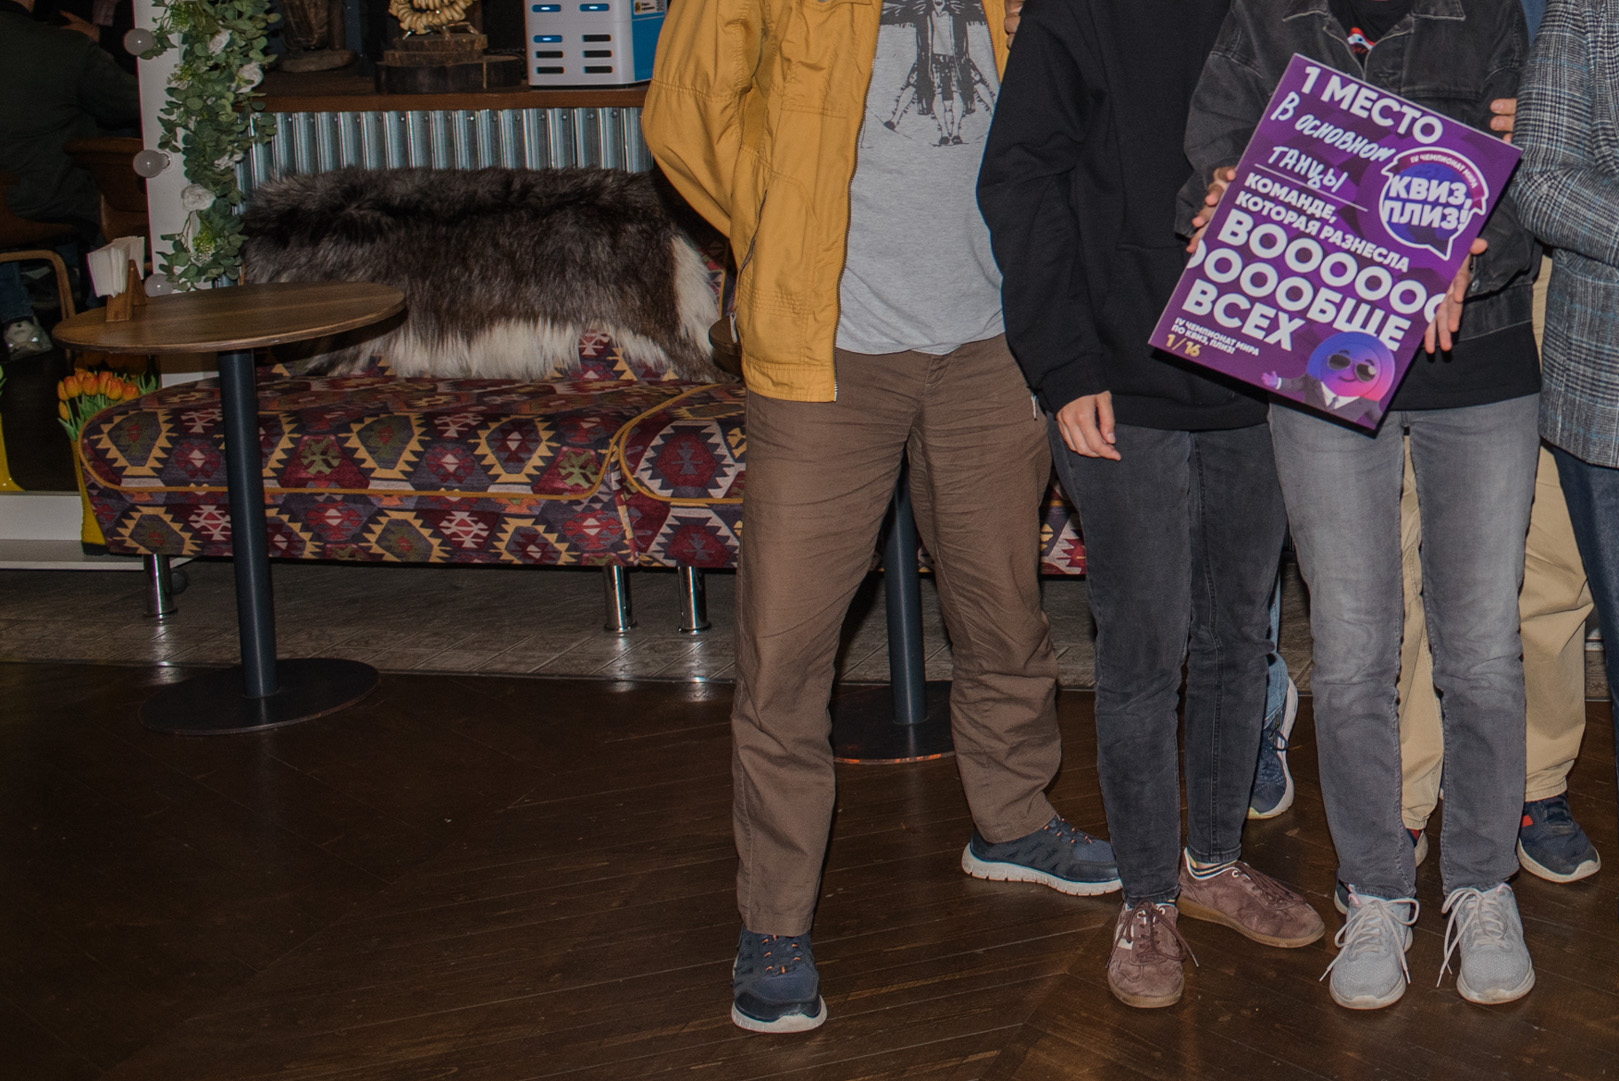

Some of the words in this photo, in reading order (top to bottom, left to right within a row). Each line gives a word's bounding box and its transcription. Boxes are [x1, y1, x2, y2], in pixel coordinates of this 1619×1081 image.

[1270, 91, 1300, 121] В
[1301, 66, 1321, 94] 1
[1320, 74, 1443, 144] МЕСТО
[1420, 154, 1466, 172] ЧЕМПИОНАТ
[1462, 169, 1478, 188] МИРА
[1244, 171, 1337, 225] КОМАНДЕ,
[1389, 175, 1472, 210] КВИЗ,
[1234, 191, 1323, 234] КОТОРАЯ
[1319, 225, 1410, 272] РАЗНЕСЛА
[1383, 200, 1469, 230] ПЛИЗ!
[1182, 278, 1305, 351] ВСЕХ
[1171, 325, 1186, 334] ПО
[1185, 329, 1209, 345] КВИЗ,
[1209, 339, 1236, 354] ПЛИЗ!
[1175, 317, 1186, 326] IV
[1186, 321, 1237, 346] ЧЕМПИОНАТ
[1236, 341, 1259, 356] МИРА
